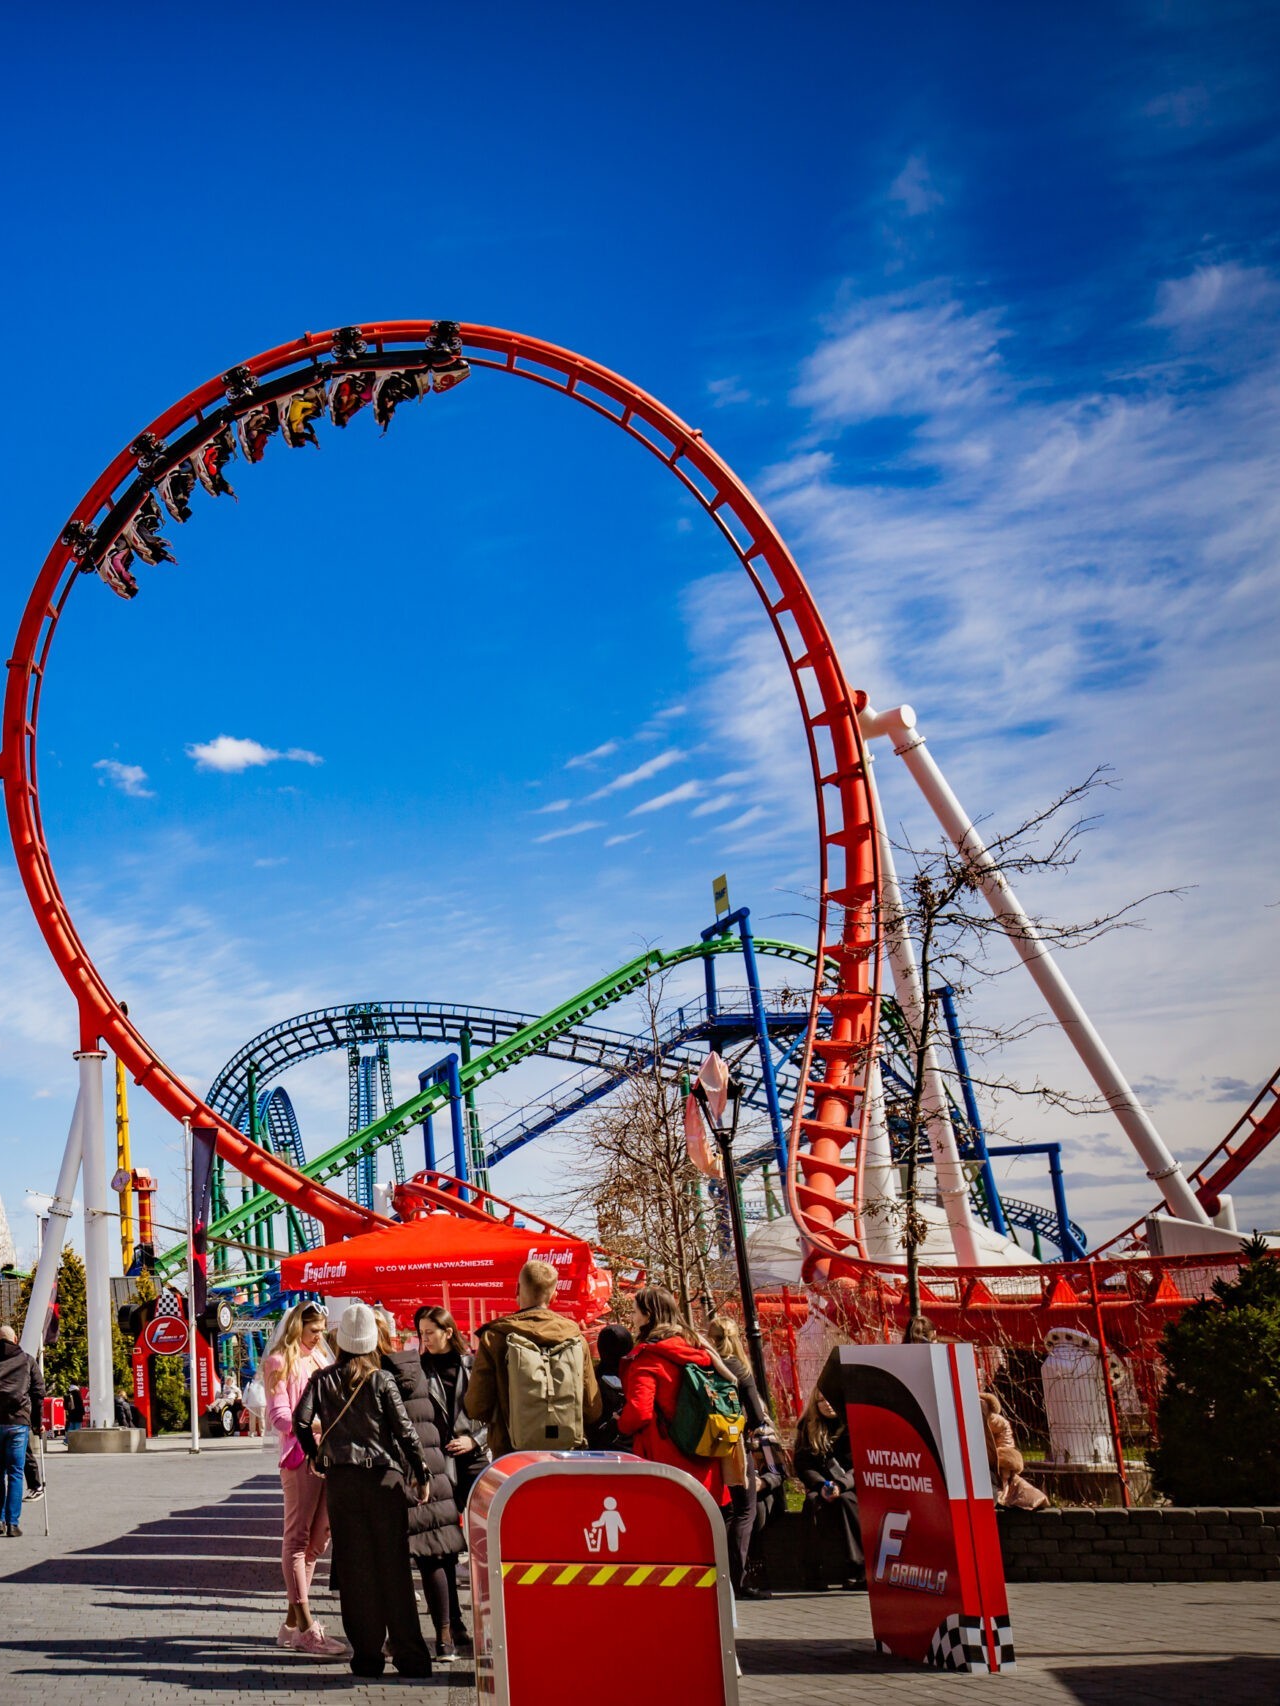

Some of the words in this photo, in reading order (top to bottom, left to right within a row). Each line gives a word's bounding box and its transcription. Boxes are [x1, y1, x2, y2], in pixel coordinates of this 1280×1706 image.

[300, 1261, 348, 1283] Segafredo
[407, 1262, 432, 1271] KAWIE
[433, 1259, 495, 1269] NAJWAŻNIEJSZE
[199, 1357, 209, 1397] ENTRANCE
[867, 1449, 921, 1469] WITAMY
[863, 1471, 933, 1493] WELCOME
